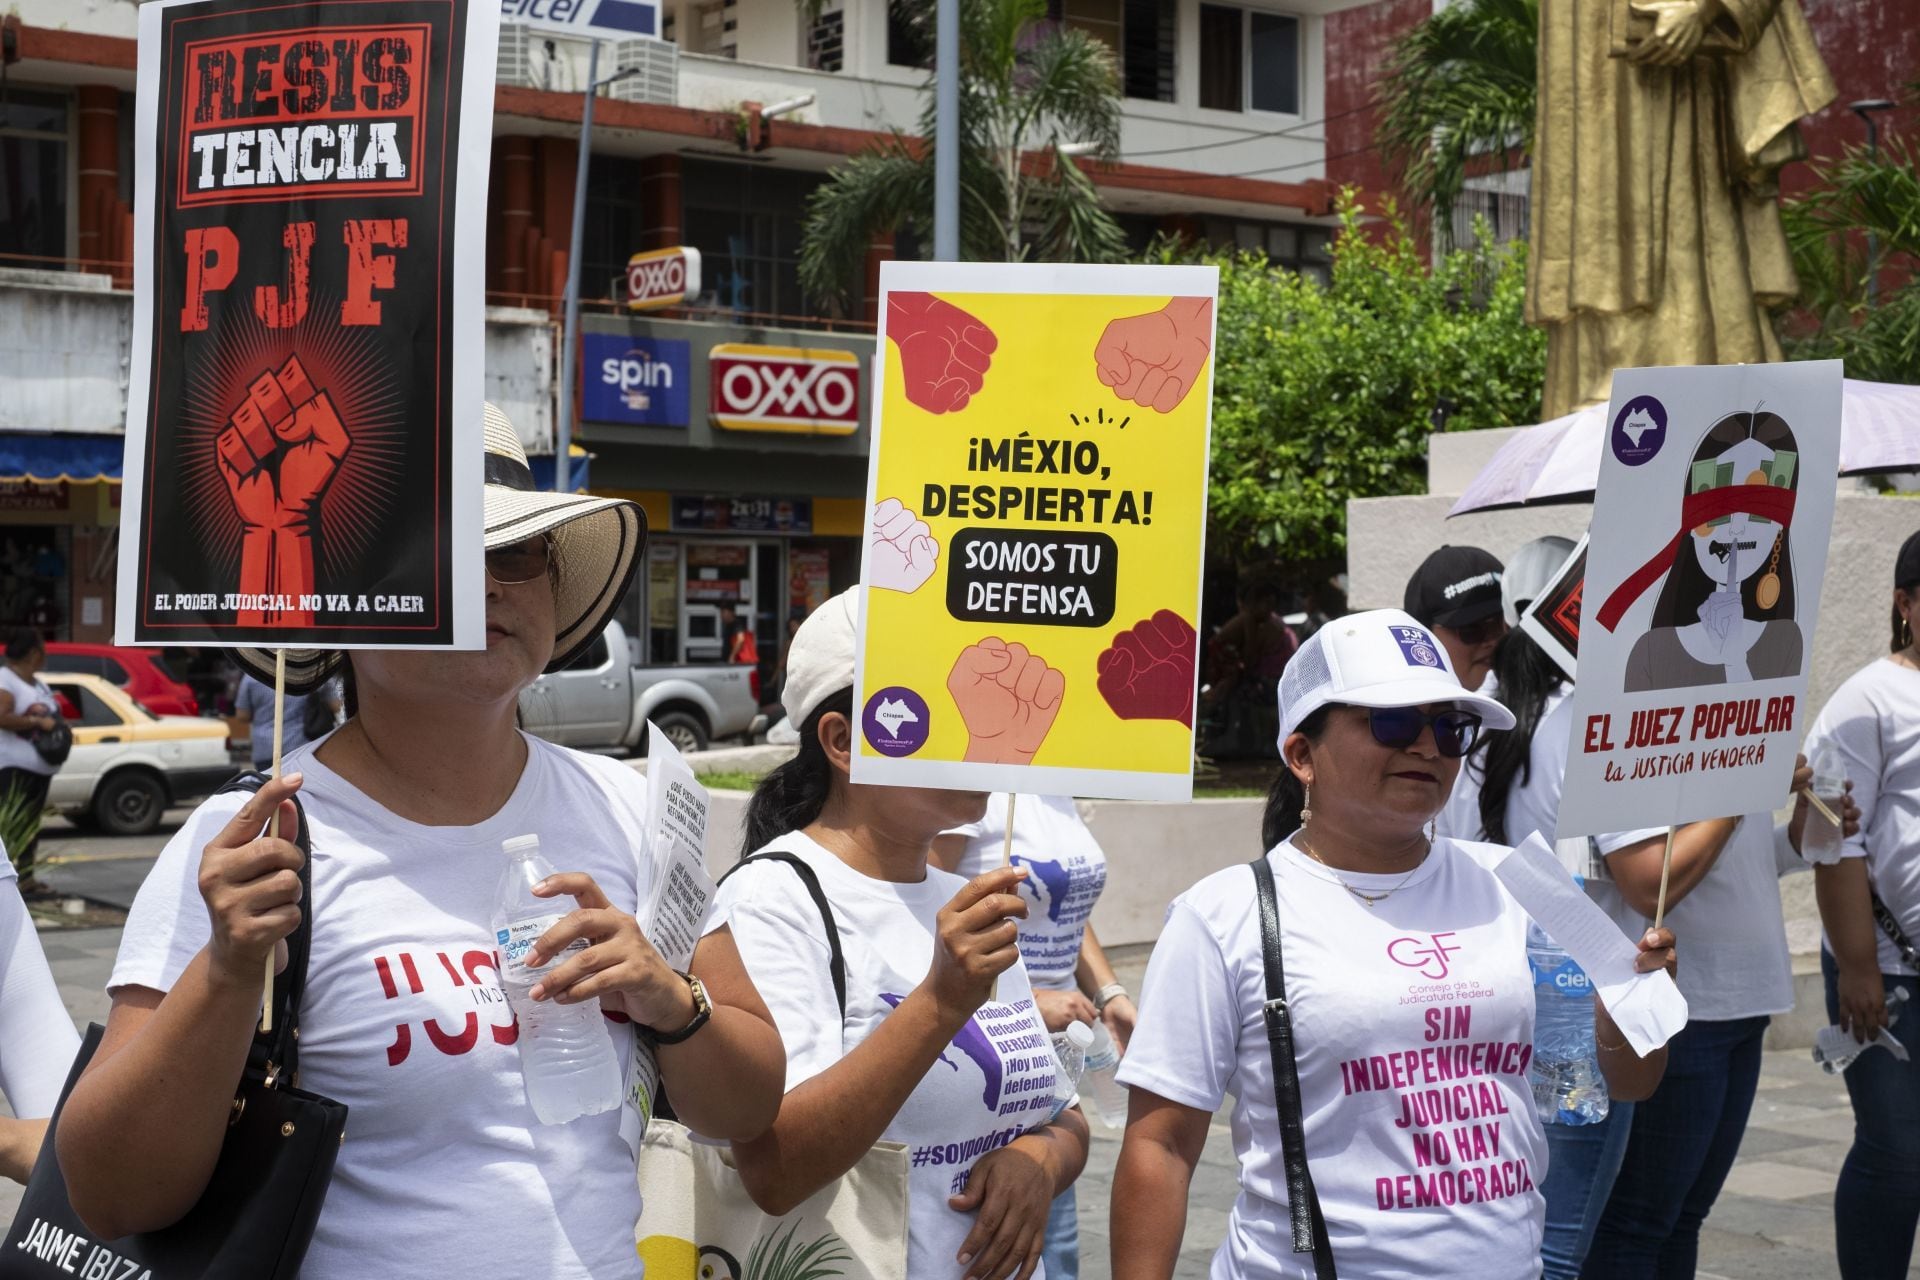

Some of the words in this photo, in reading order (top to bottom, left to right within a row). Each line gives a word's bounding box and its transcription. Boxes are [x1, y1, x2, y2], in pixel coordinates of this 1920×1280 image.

[194, 38, 412, 124] RESIS
[193, 122, 405, 189] TENCIA
[629, 258, 683, 298] OXXO
[602, 357, 672, 391] spin
[722, 364, 854, 417] OXXO
[968, 431, 1110, 480] ¡MÉXIO,
[922, 484, 1153, 525] DESPIERTA!
[965, 540, 1057, 573] SOMOS
[1064, 544, 1100, 575] TU
[155, 594, 171, 610] EL
[175, 594, 217, 610] PODER
[220, 594, 294, 611] JUDICIAL
[299, 595, 321, 611] NO
[326, 595, 351, 611] VA
[355, 595, 369, 612] A
[374, 595, 424, 613] CAER
[967, 582, 1094, 617] DEFENSA
[1584, 714, 1614, 753] EL
[1624, 707, 1685, 749] JUEZ
[1690, 695, 1795, 741] POPULAR
[1604, 761, 1626, 782] la
[1701, 738, 1766, 772] VENDERÁ
[1019, 933, 1048, 943] Todos
[1398, 992, 1454, 1005] Judicatura
[1456, 988, 1494, 1000] Federal
[1408, 983, 1452, 995] Consejo
[1455, 982, 1467, 990] de
[986, 1018, 1033, 1037] defender
[1424, 1005, 1471, 1042] SIN
[1005, 1058, 1030, 1076] ¡Hoy
[1032, 1055, 1049, 1069] nos
[998, 1099, 1028, 1117] para
[1395, 1081, 1508, 1128] JUDICIAL
[1412, 1131, 1451, 1167] NO
[1454, 1122, 1500, 1162] HAY
[1376, 1159, 1534, 1211] DEMOCRACIA
[17, 1217, 88, 1274] JAIME
